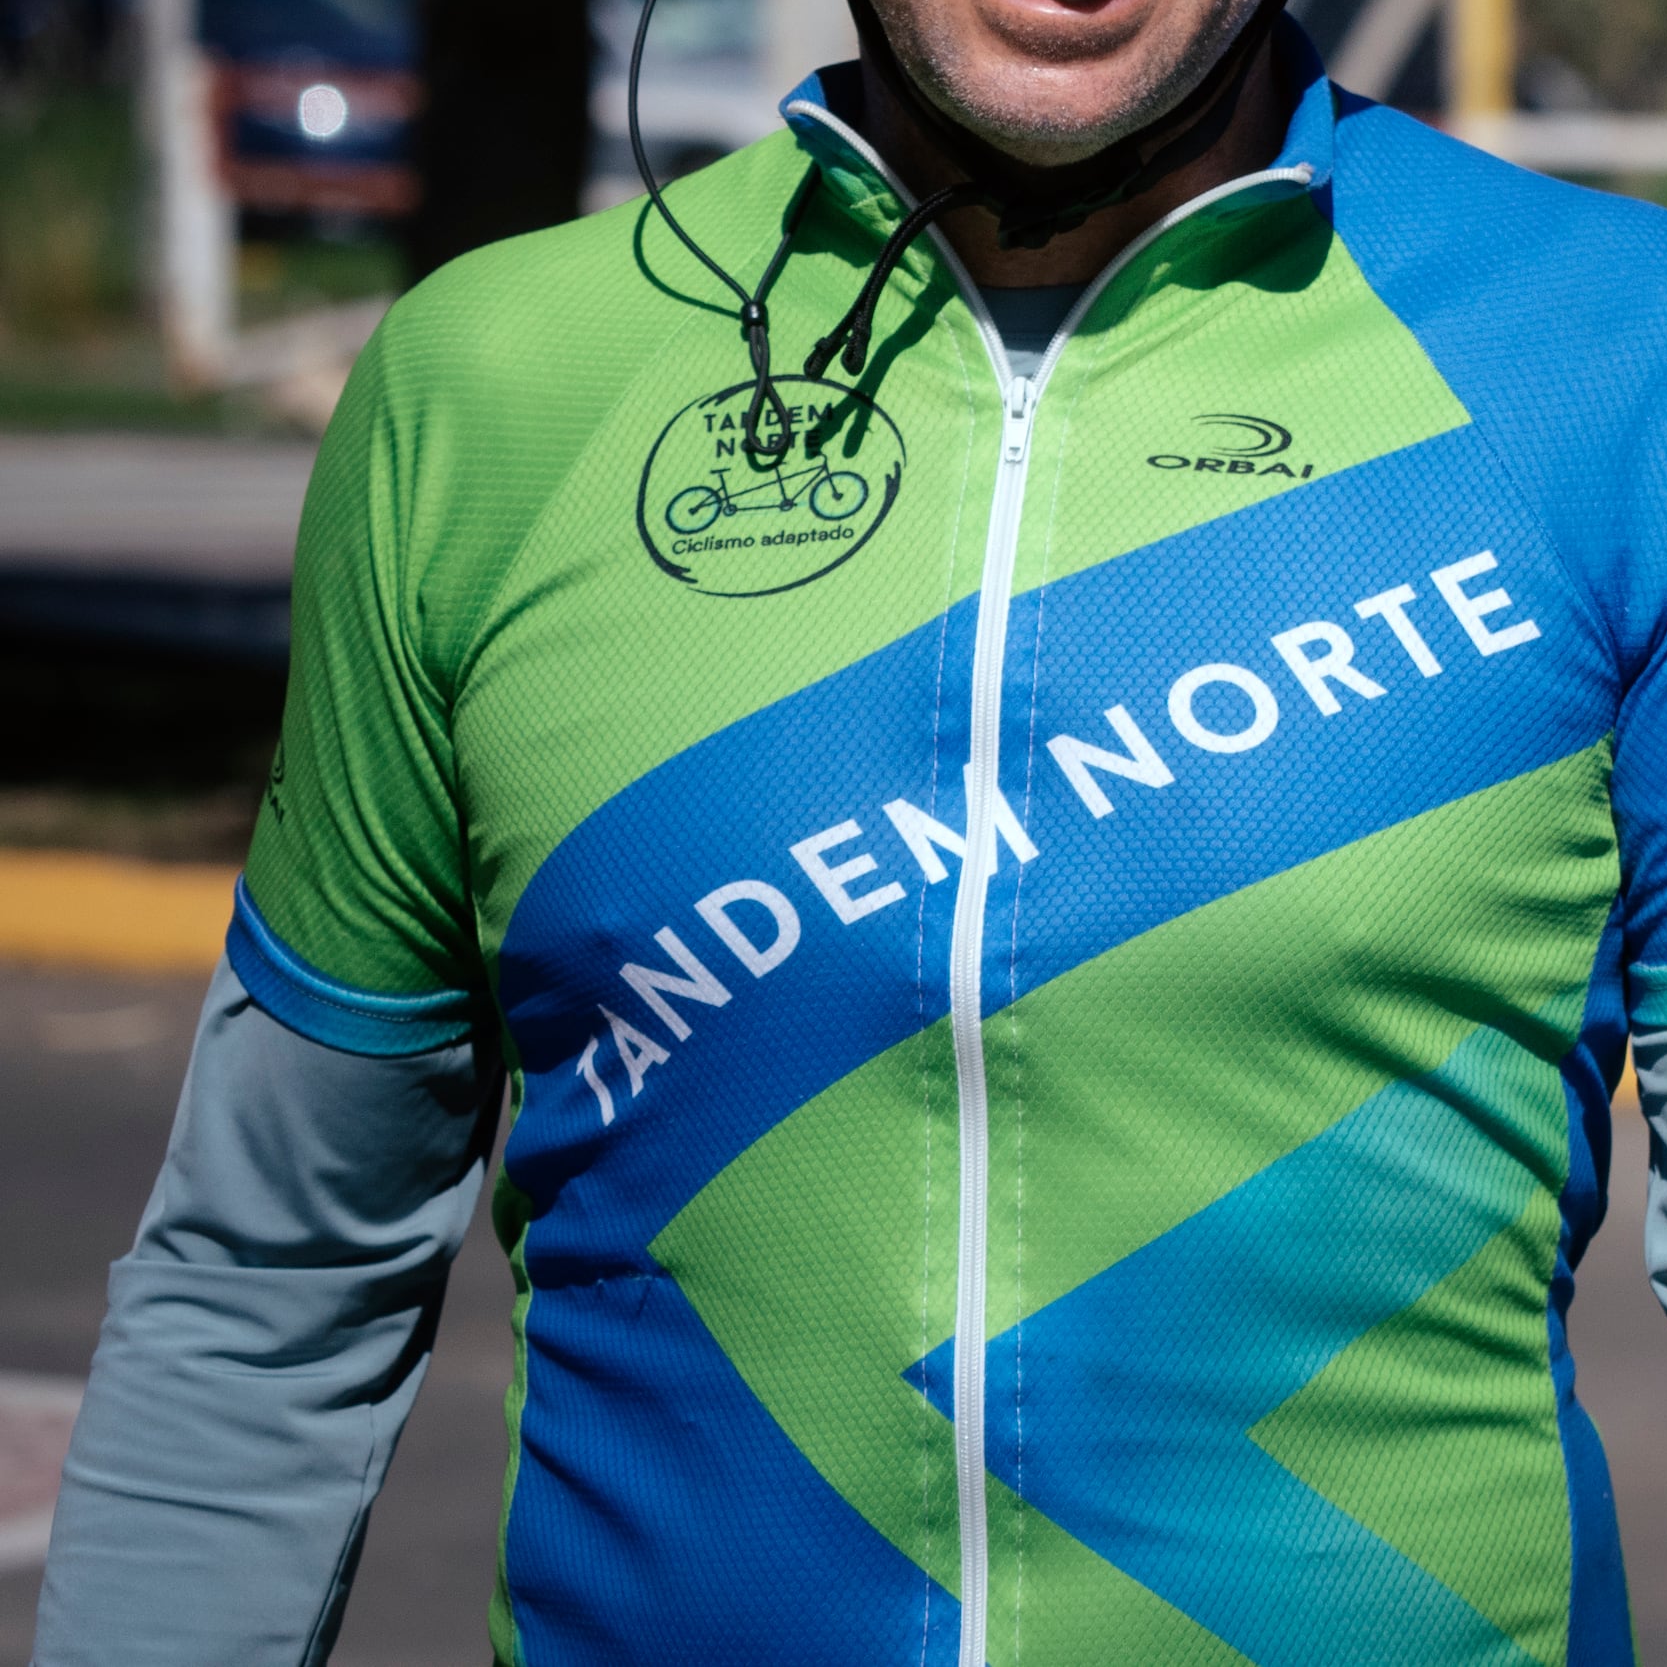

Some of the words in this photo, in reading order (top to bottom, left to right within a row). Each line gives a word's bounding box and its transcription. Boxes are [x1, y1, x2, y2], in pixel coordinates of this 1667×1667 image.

[1146, 454, 1314, 479] ORBAI
[672, 536, 755, 555] Ciclismo
[761, 525, 855, 547] adaptado
[575, 762, 1041, 1127] TANDEM
[1046, 550, 1541, 820] NORTE
